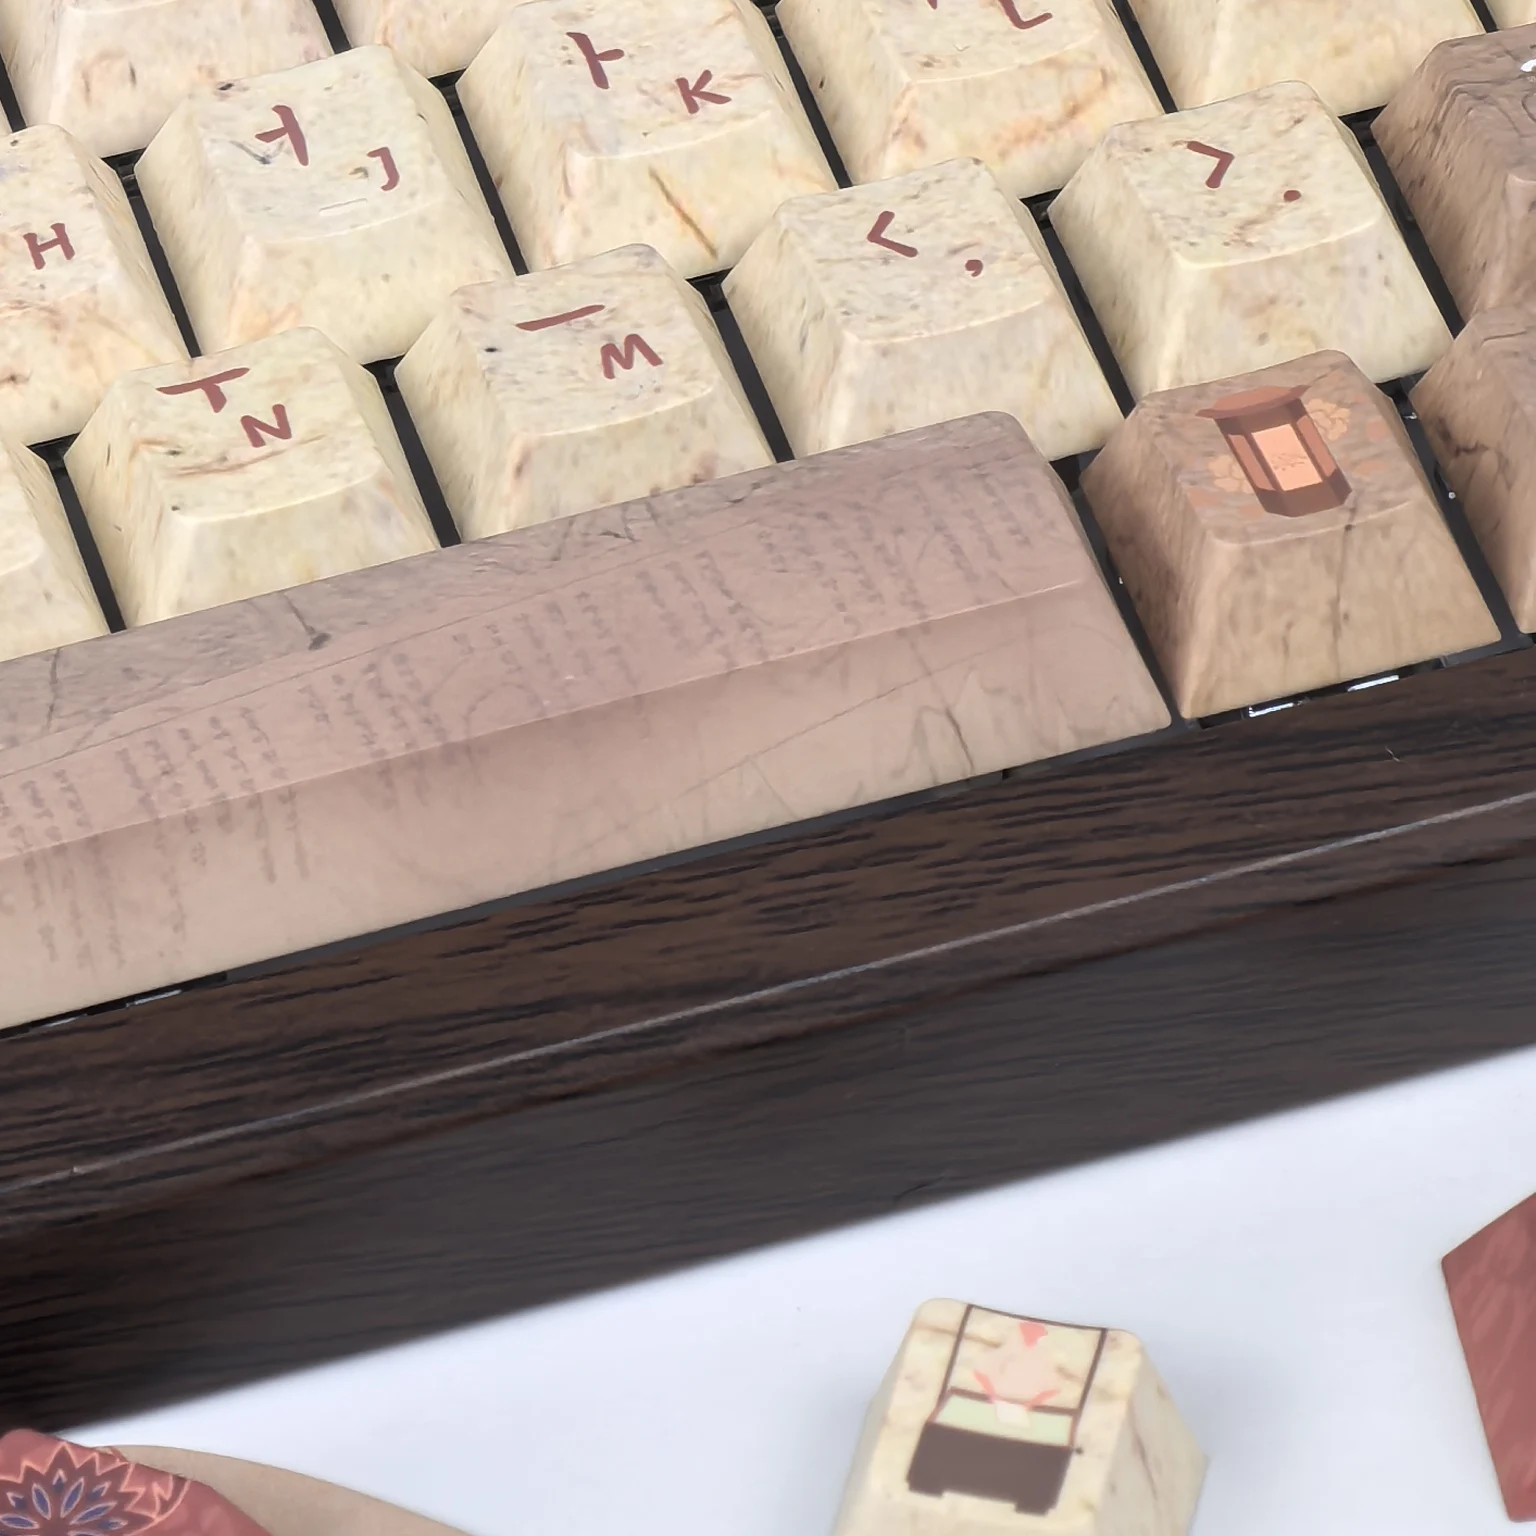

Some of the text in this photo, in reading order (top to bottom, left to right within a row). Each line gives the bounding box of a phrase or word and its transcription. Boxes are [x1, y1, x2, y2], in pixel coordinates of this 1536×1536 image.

[674, 69, 731, 116] K
[366, 147, 399, 192] J
[1185, 139, 1234, 190] >
[22, 222, 75, 271] H
[865, 210, 917, 258] <
[599, 333, 663, 381] M
[239, 402, 292, 449] N
